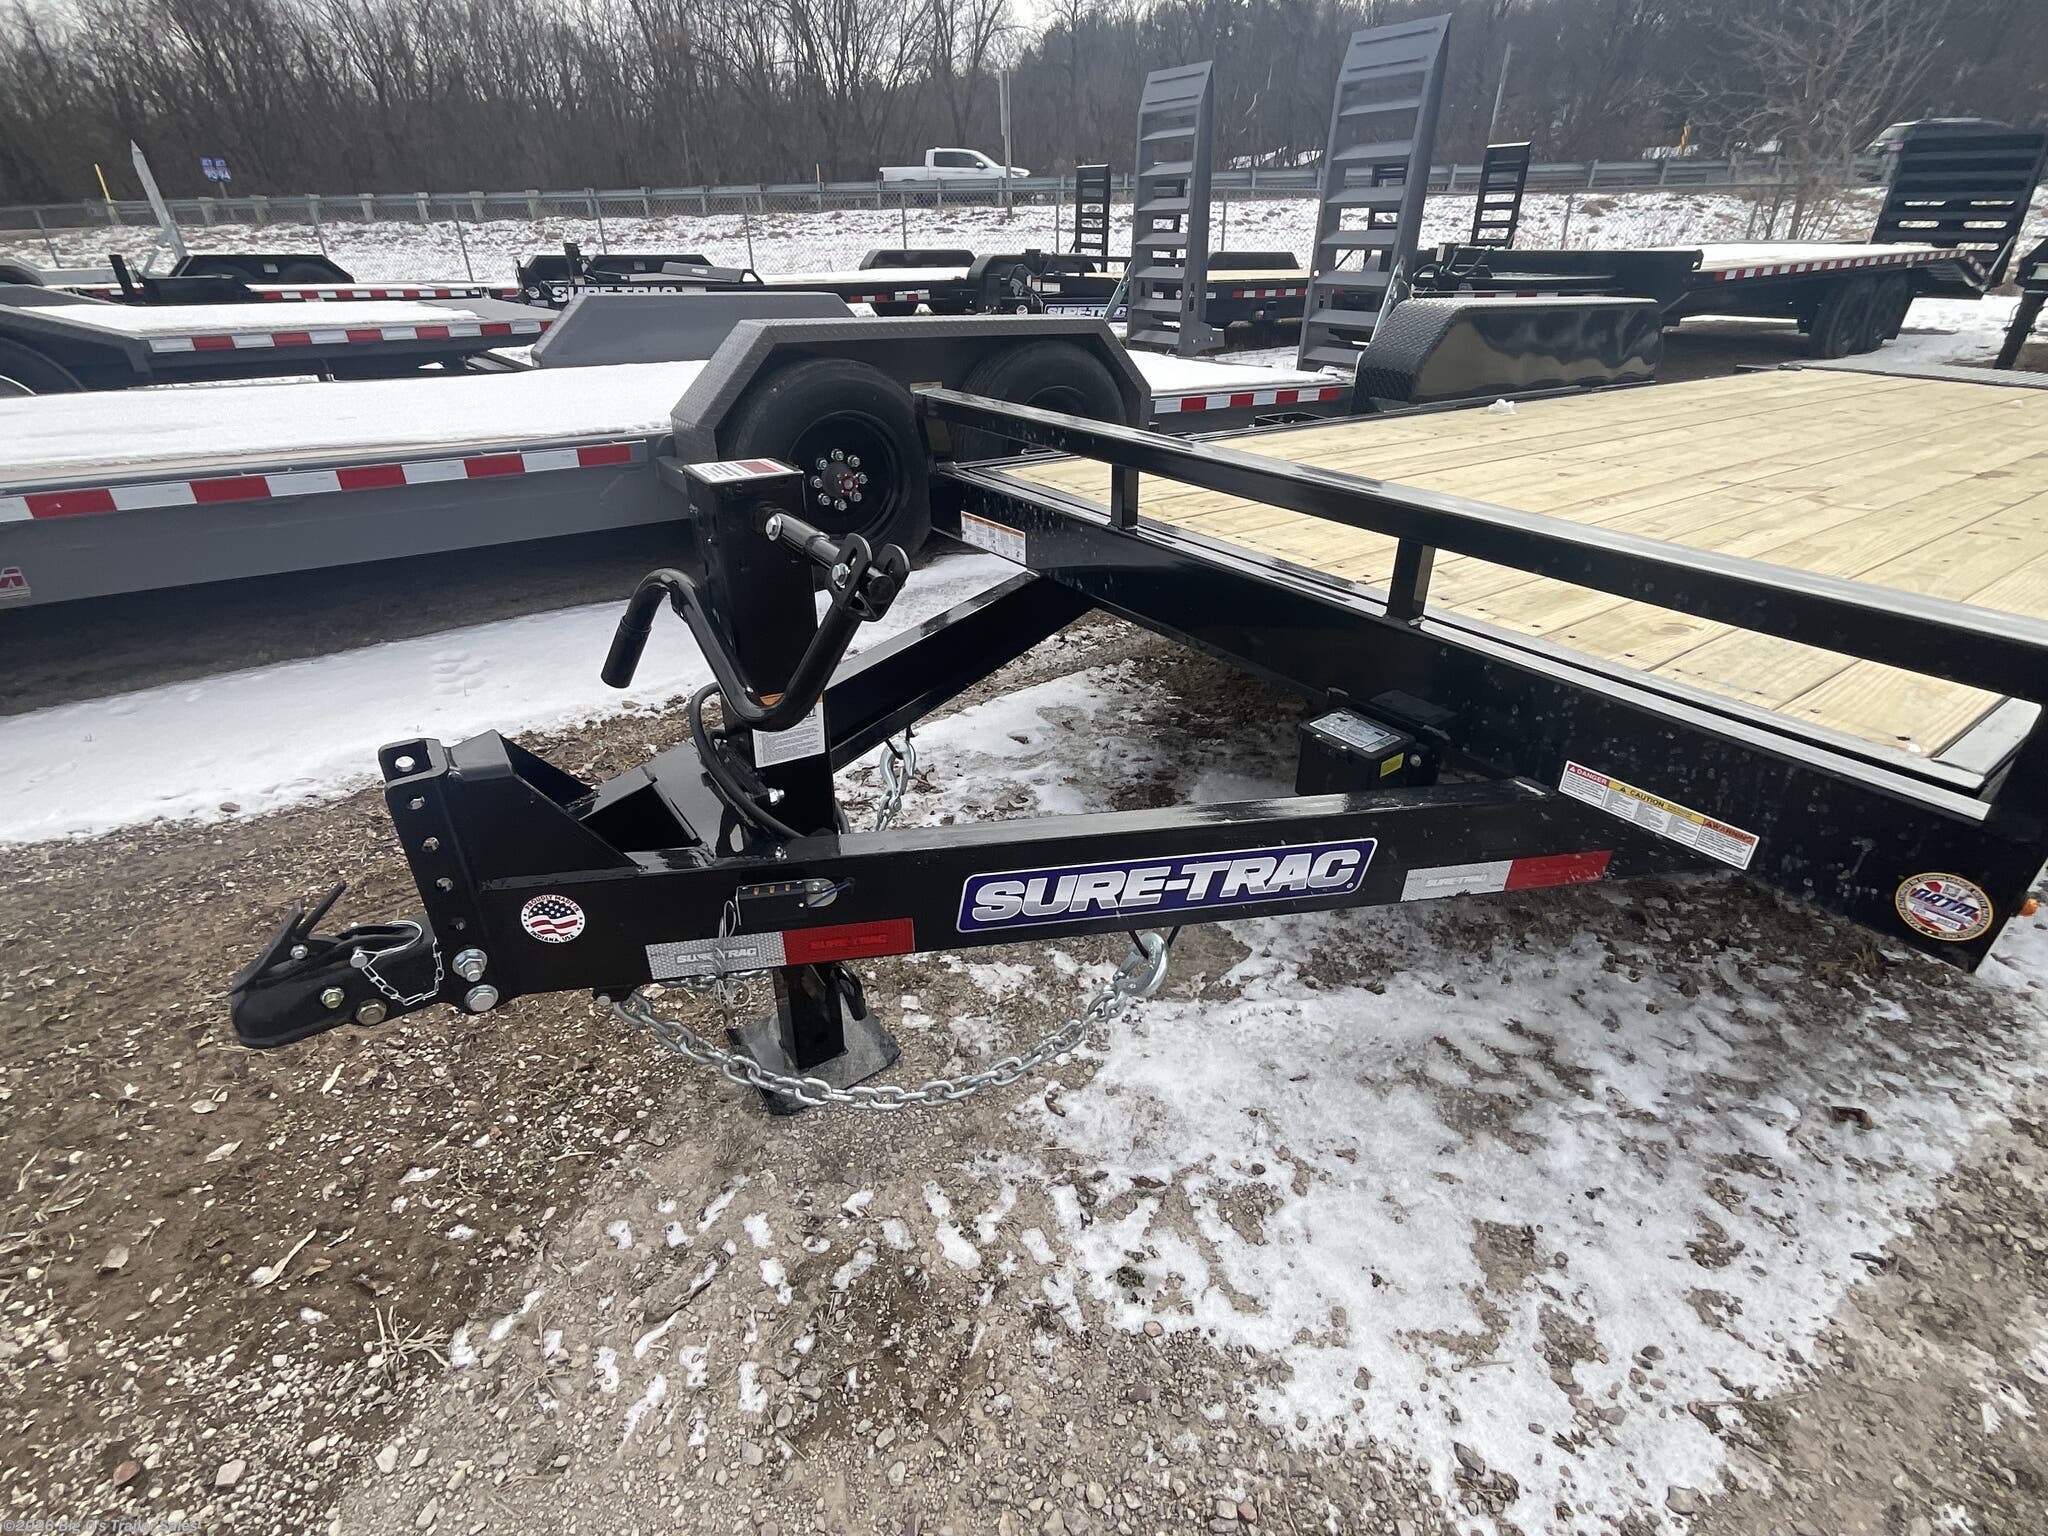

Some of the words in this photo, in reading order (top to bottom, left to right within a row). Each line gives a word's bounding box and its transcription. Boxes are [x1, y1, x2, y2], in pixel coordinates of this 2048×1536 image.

[1576, 769, 1608, 786] DANGER
[1629, 789, 1665, 809] CAUTION
[970, 848, 1362, 922] SURE-TRAC
[525, 895, 553, 910] PROUDLY
[554, 896, 575, 906] MADE
[561, 934, 576, 942] USA
